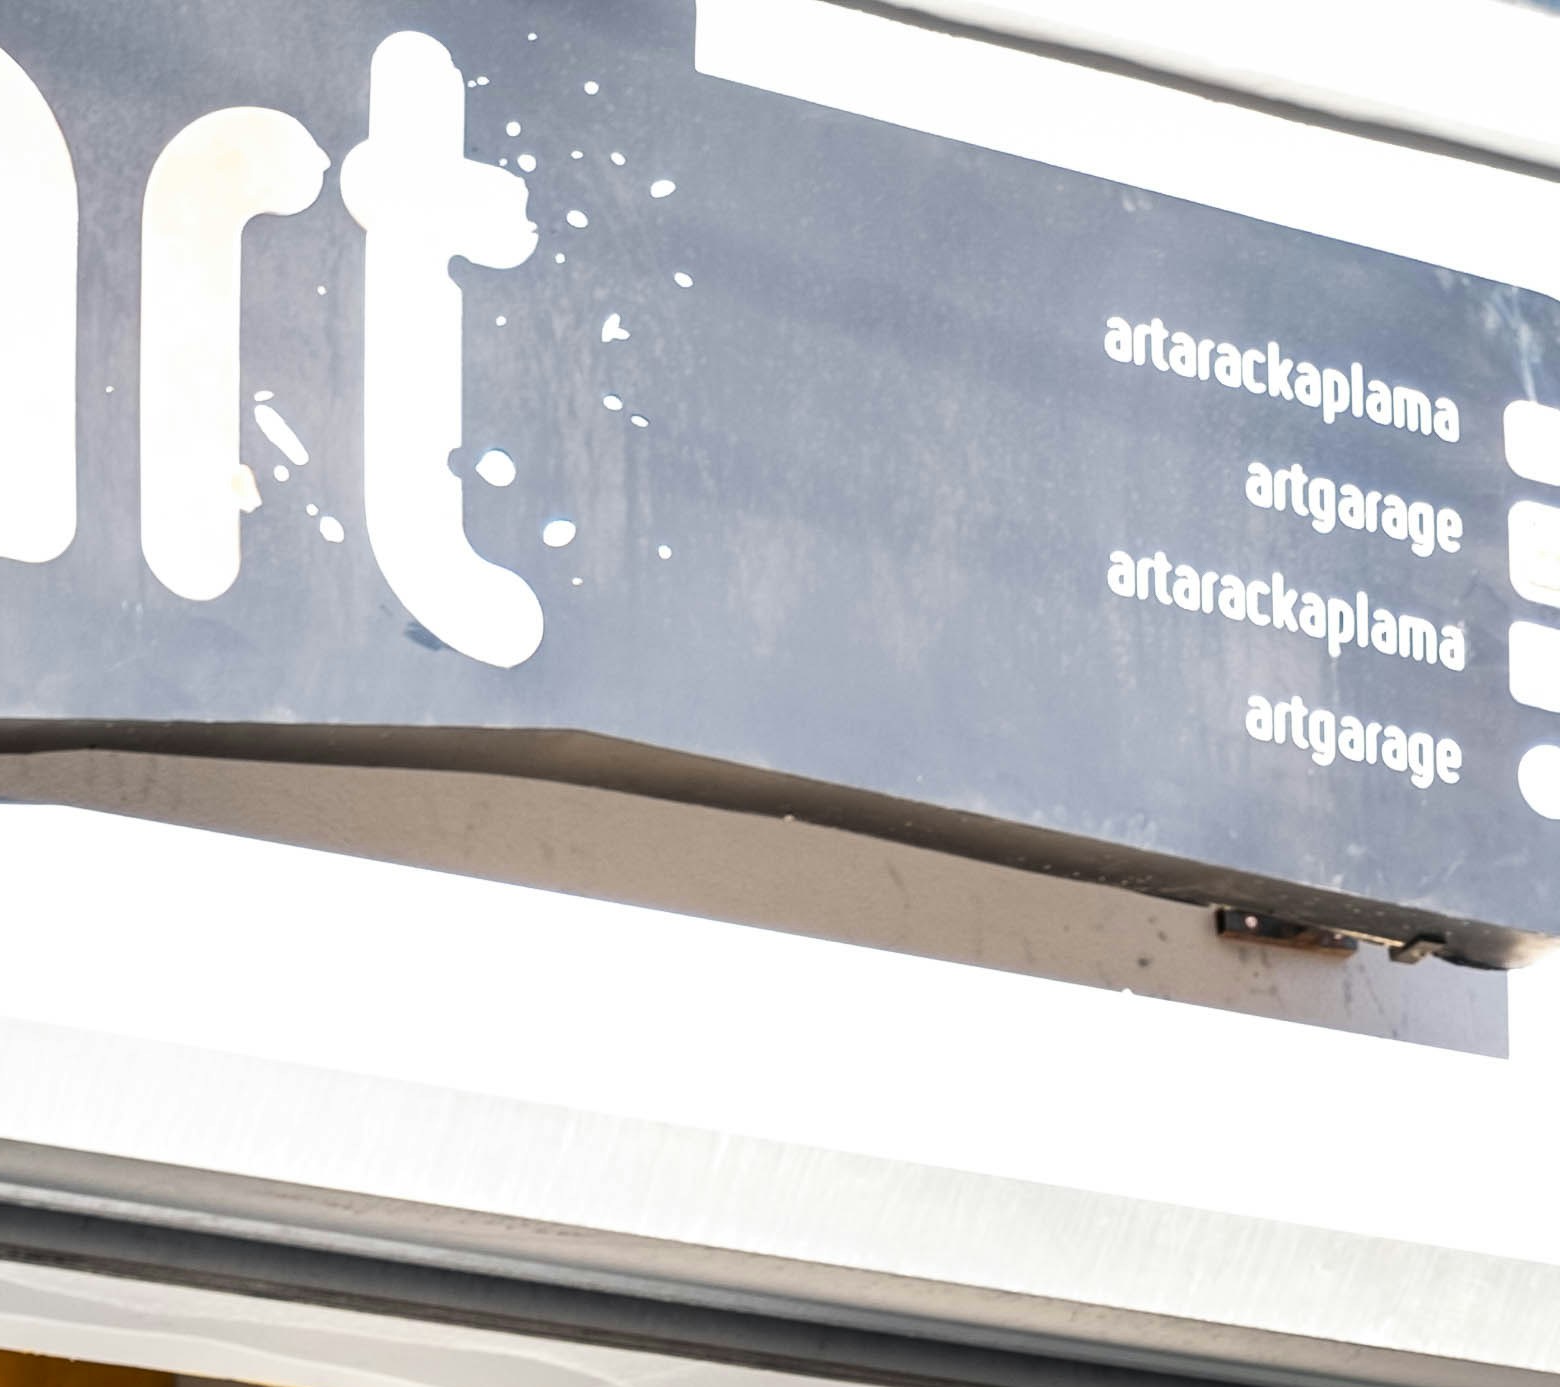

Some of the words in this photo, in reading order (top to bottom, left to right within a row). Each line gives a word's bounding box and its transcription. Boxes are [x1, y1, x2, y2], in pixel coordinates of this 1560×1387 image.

[1104, 316, 1460, 442] artarackaplama
[1245, 461, 1463, 557] artgarage
[1107, 550, 1465, 671] artarackaplama
[1245, 695, 1462, 789] artgarage
